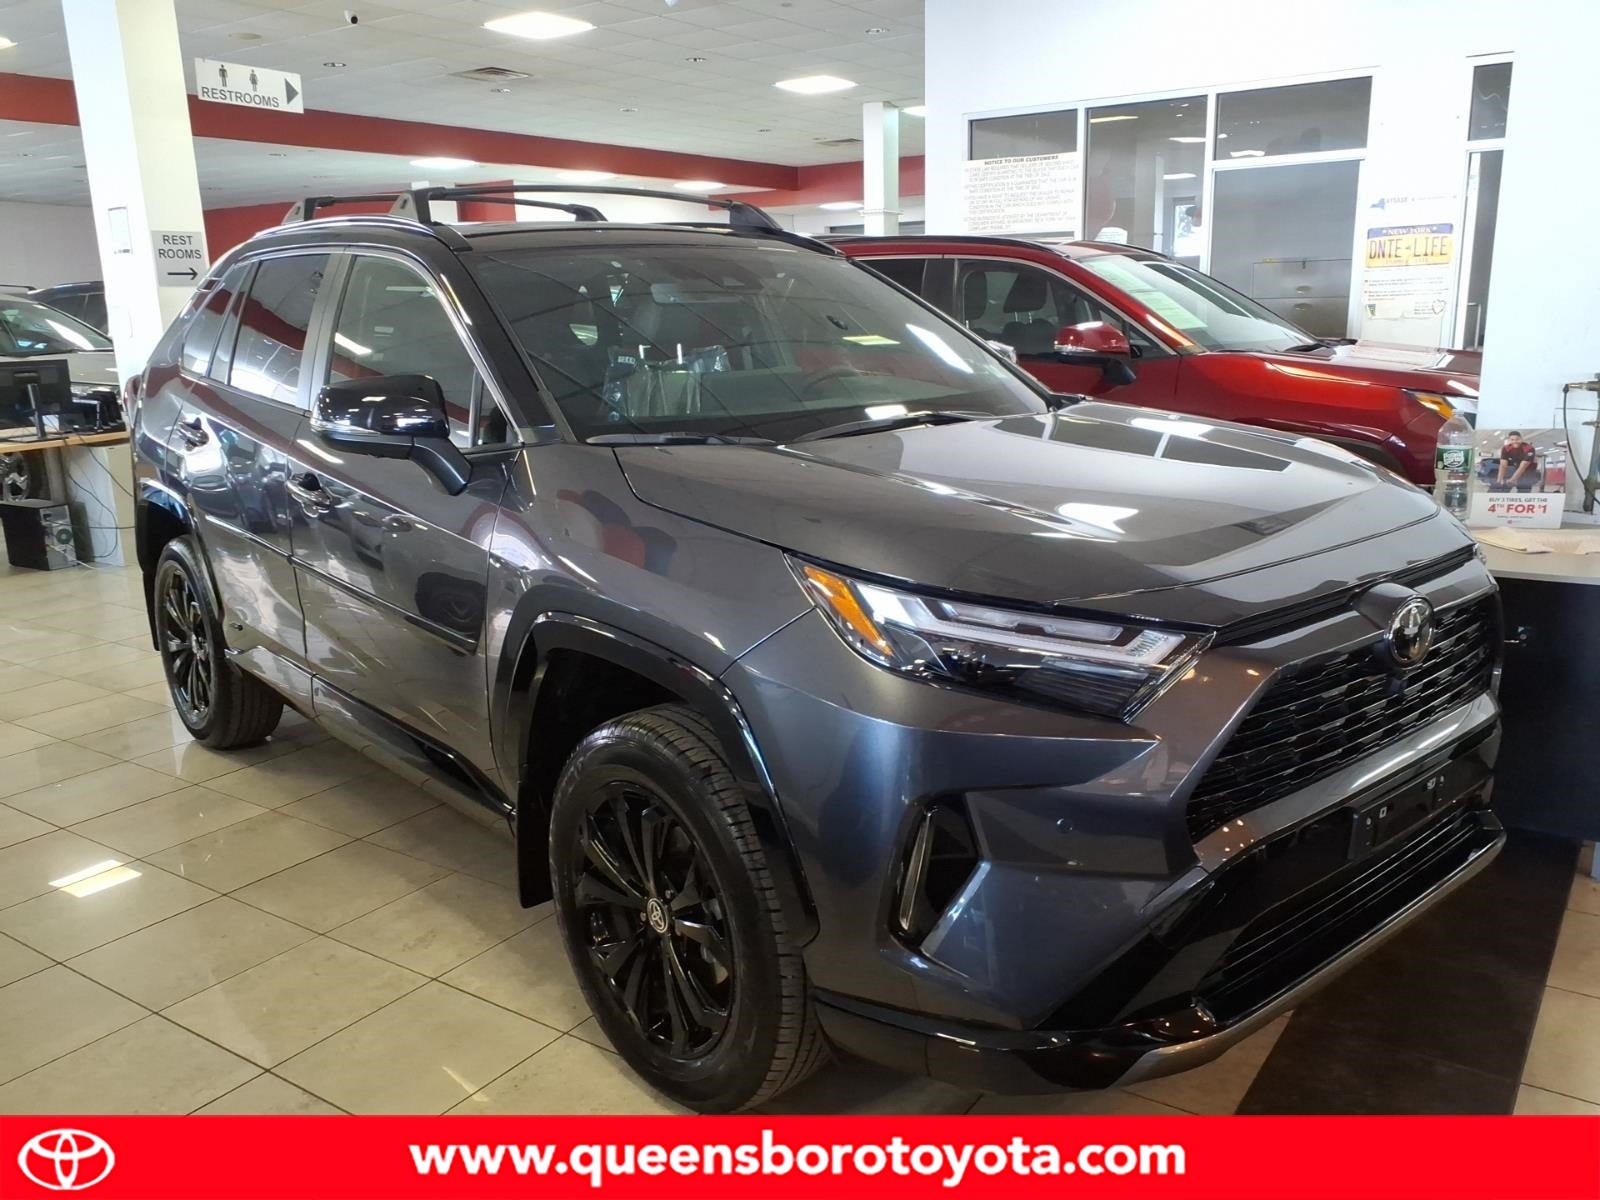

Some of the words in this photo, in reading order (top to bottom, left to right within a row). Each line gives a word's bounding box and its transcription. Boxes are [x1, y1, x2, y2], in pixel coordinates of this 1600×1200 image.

[201, 86, 279, 108] RESTROOMS
[162, 234, 193, 245] REST
[158, 248, 202, 259] ROOMS
[1506, 503, 1536, 514] FOR
